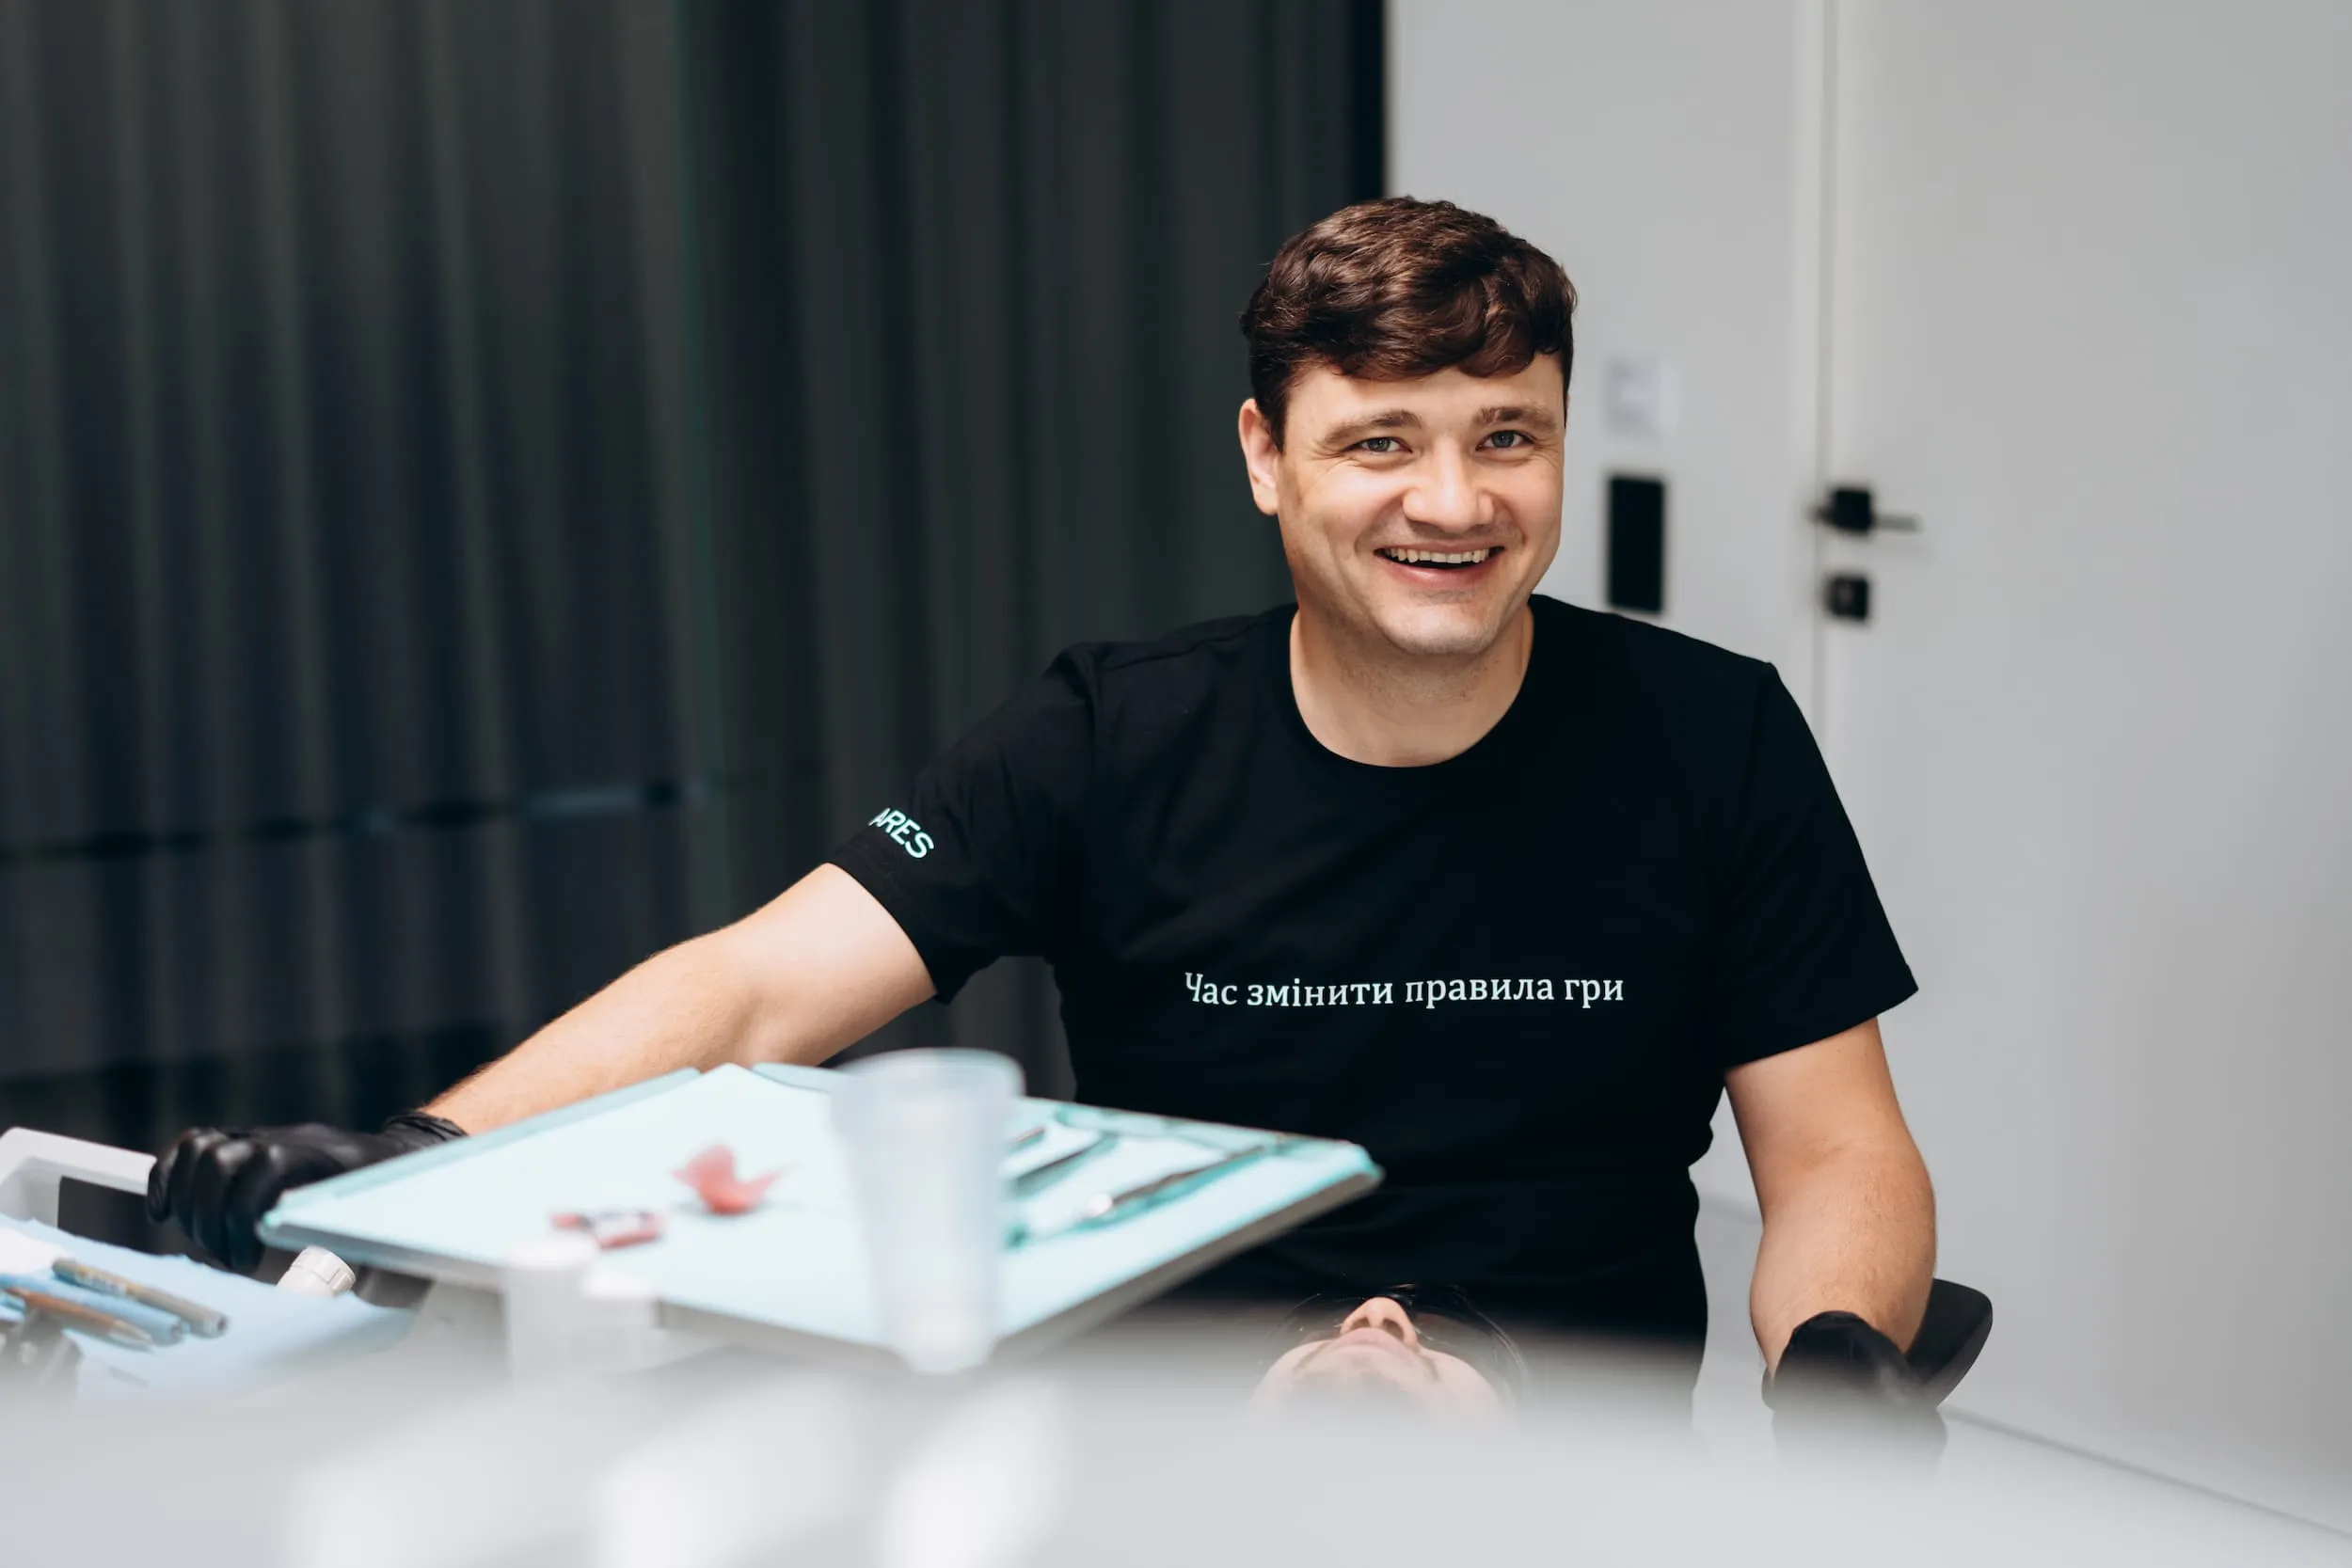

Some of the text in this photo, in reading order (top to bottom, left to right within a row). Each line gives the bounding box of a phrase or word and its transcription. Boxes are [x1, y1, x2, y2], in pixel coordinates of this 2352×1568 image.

[1184, 972, 1623, 1009] Час змінити правила гри
